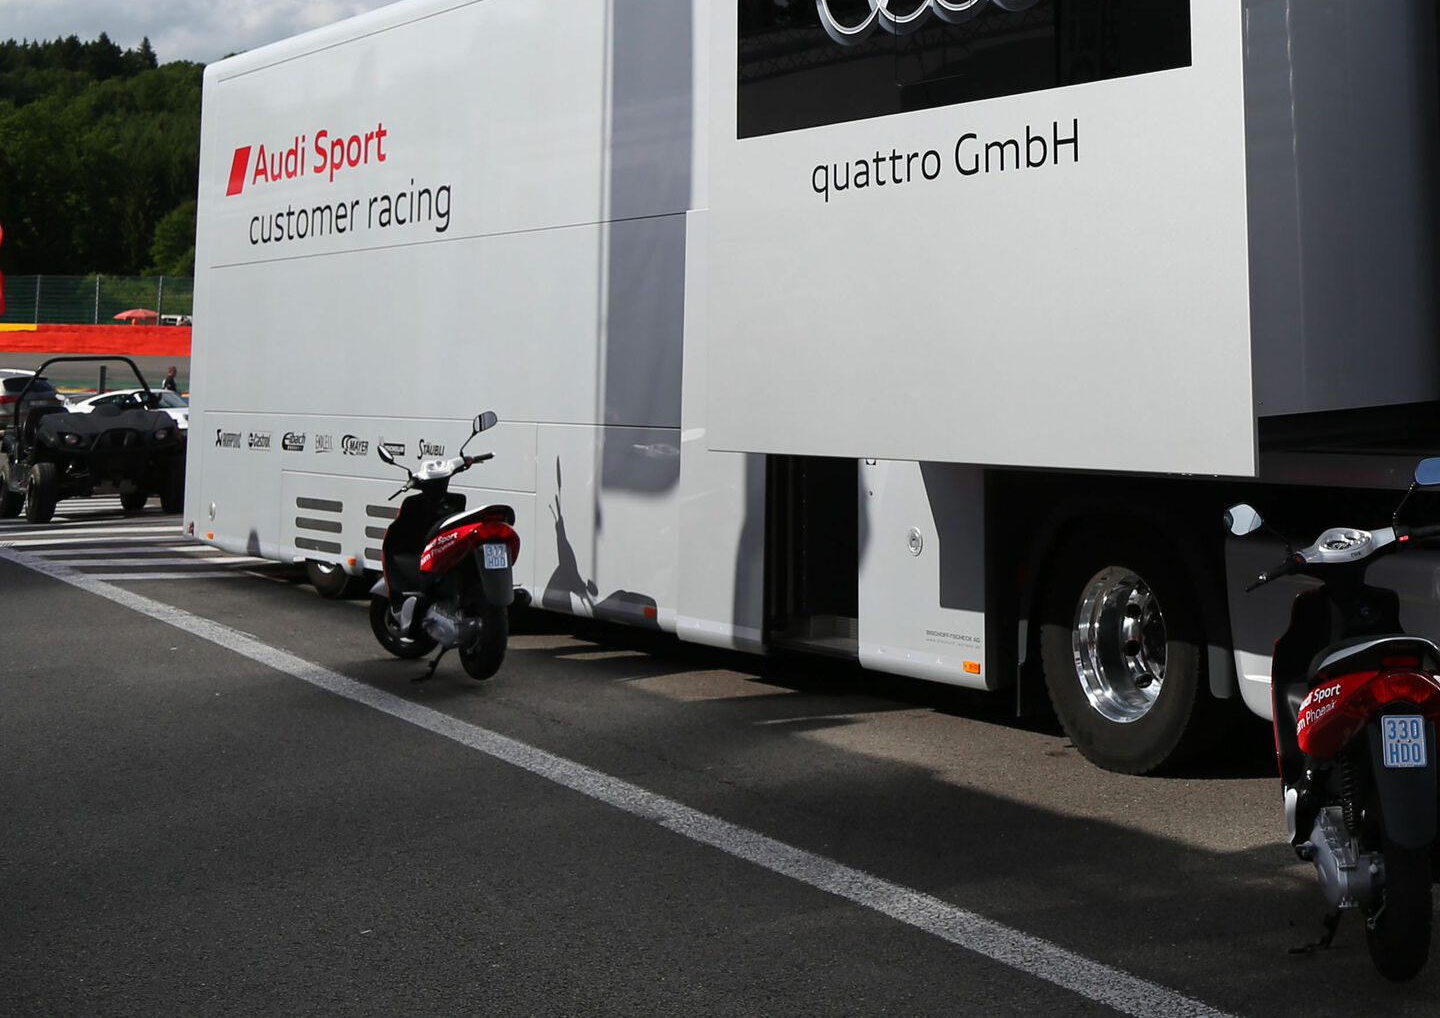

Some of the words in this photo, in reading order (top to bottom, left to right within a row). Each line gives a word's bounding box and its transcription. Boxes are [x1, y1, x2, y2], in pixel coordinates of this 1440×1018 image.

[251, 136, 306, 186] Audi
[313, 122, 388, 182] Sport
[811, 147, 942, 203] quattro
[954, 118, 1080, 176] GmbH
[249, 195, 361, 245] customer
[367, 179, 452, 233] racing
[1305, 698, 1338, 725] Phoenix
[1312, 683, 1341, 703] Sport
[1386, 719, 1420, 740] 330
